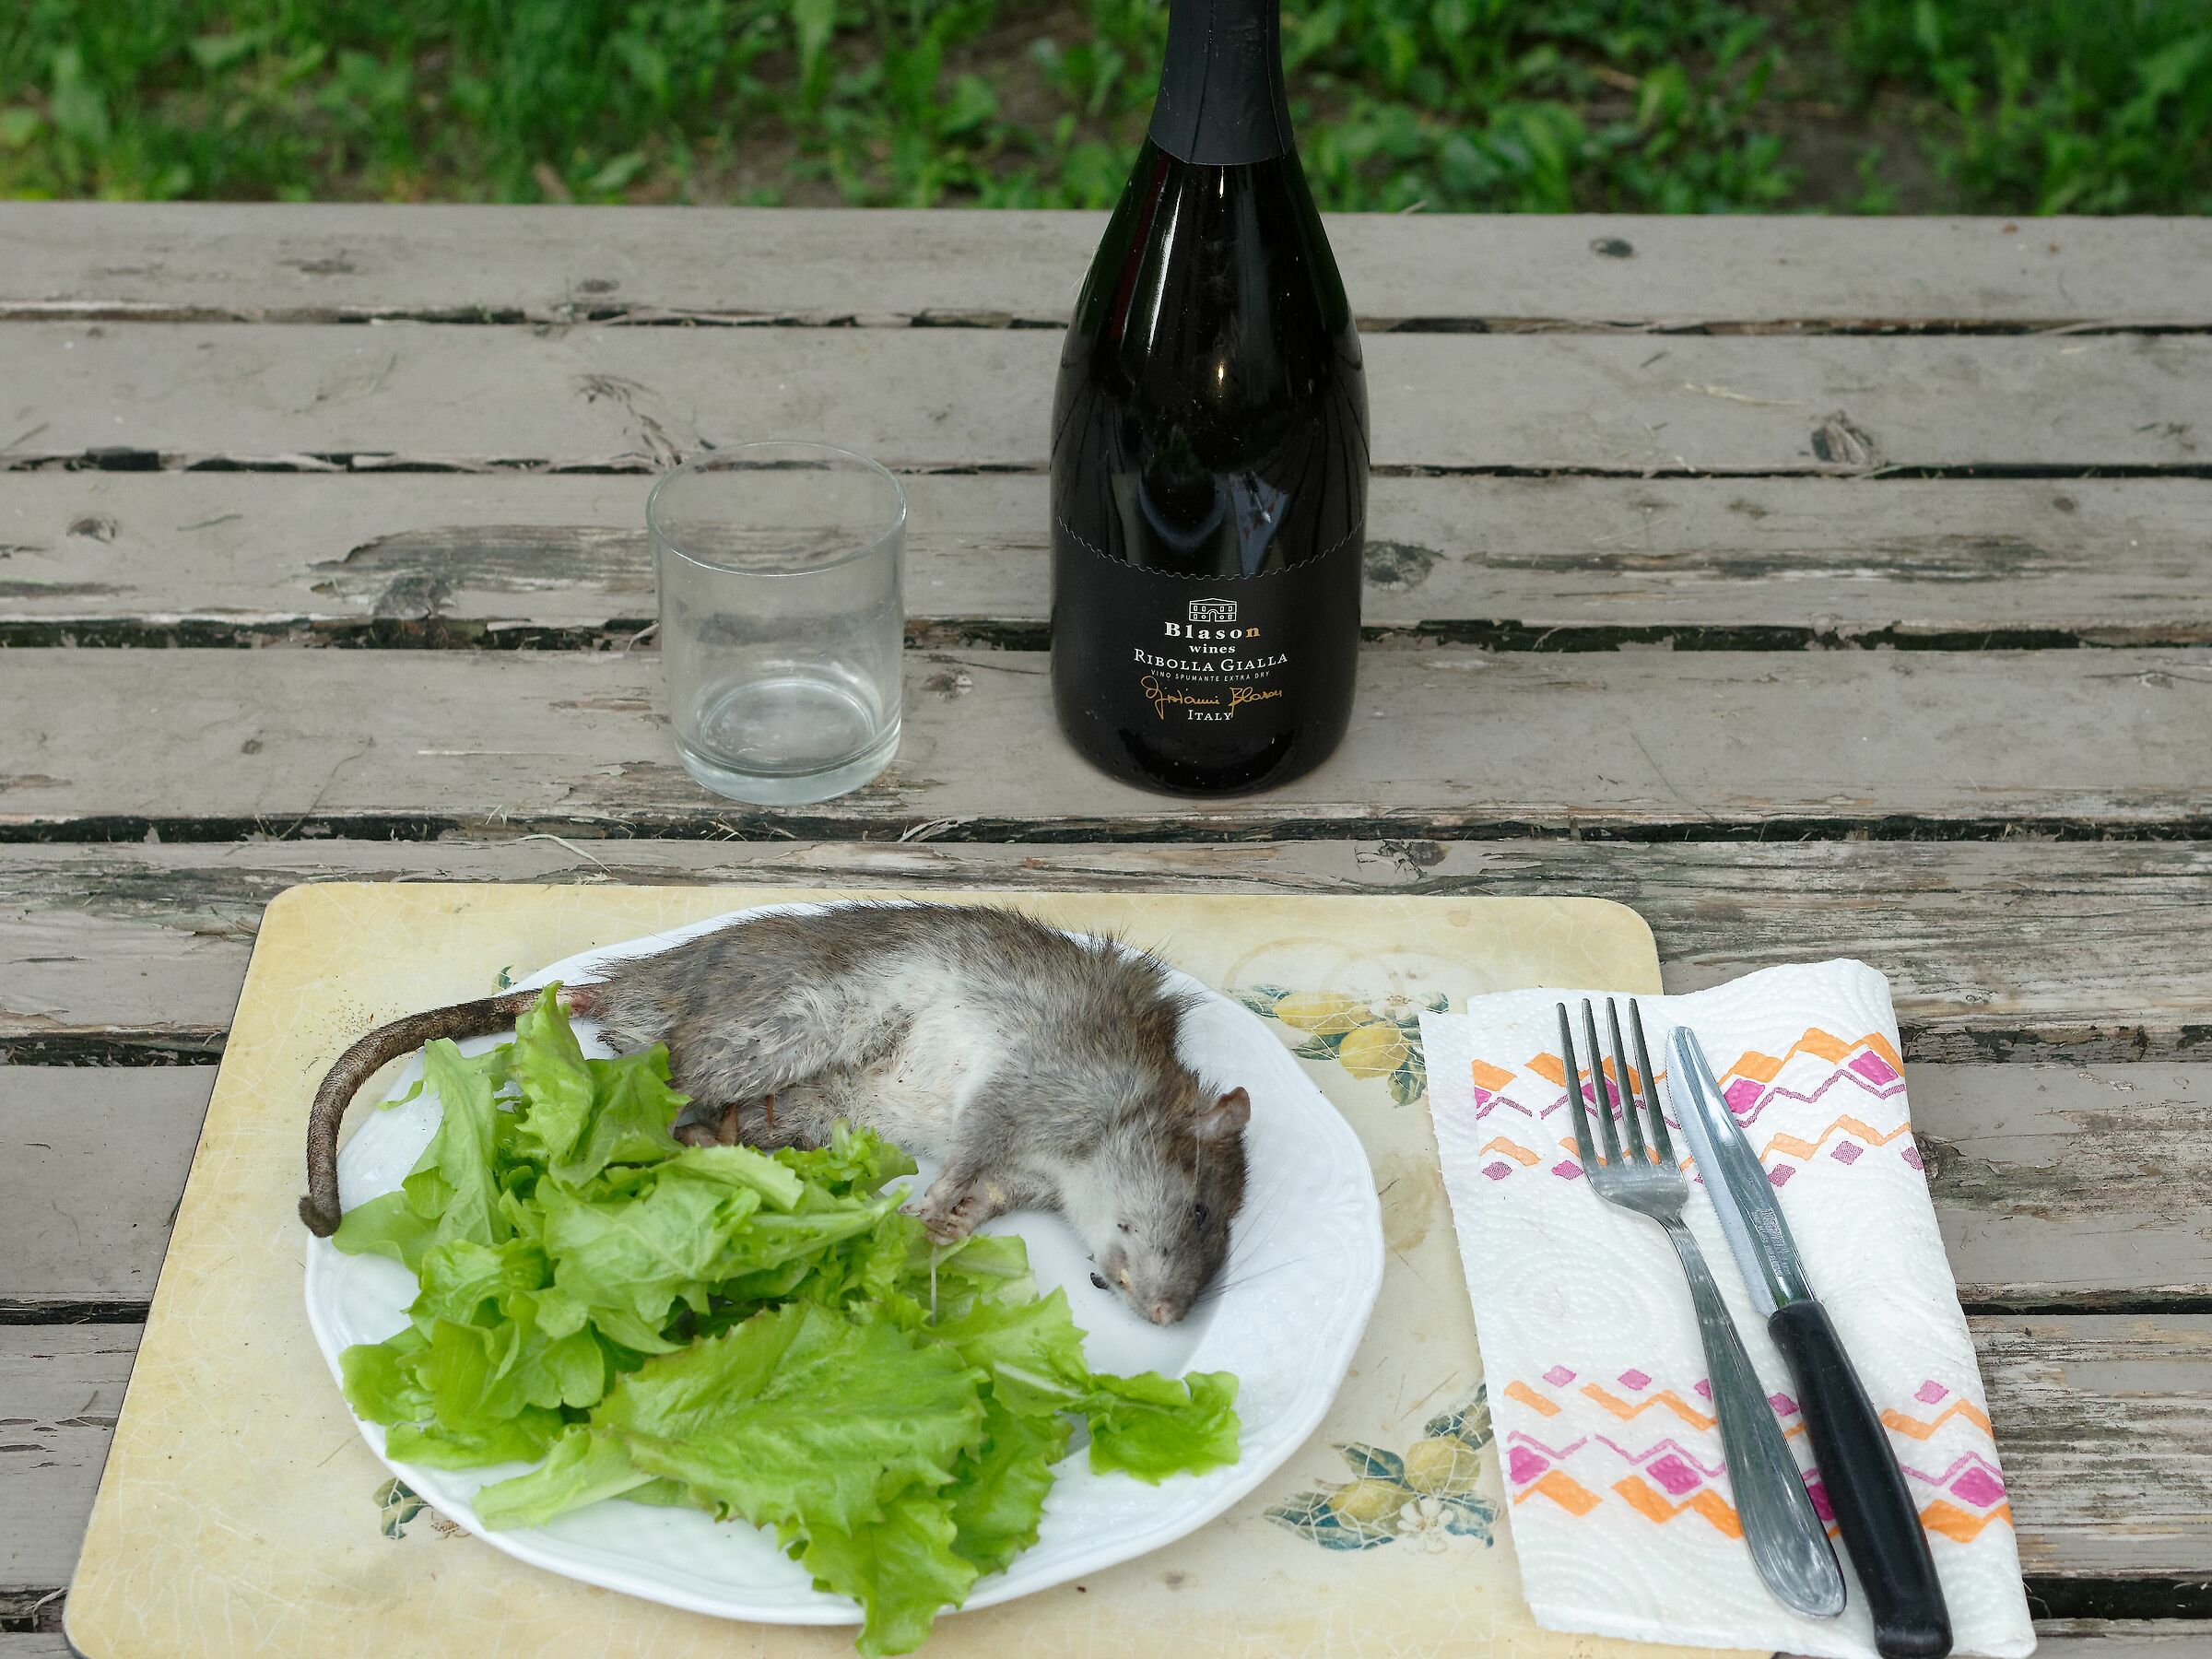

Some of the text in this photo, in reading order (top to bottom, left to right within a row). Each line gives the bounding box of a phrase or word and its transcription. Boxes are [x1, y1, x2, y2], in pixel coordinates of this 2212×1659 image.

[1164, 621, 1261, 640] Blason
[1189, 643, 1236, 653] wines
[1134, 648, 1288, 672] RIBOLLA GIALLA
[1150, 669, 1270, 682] VINO SPUMANTE EXTRA DRY
[1187, 709, 1232, 721] ITALY
